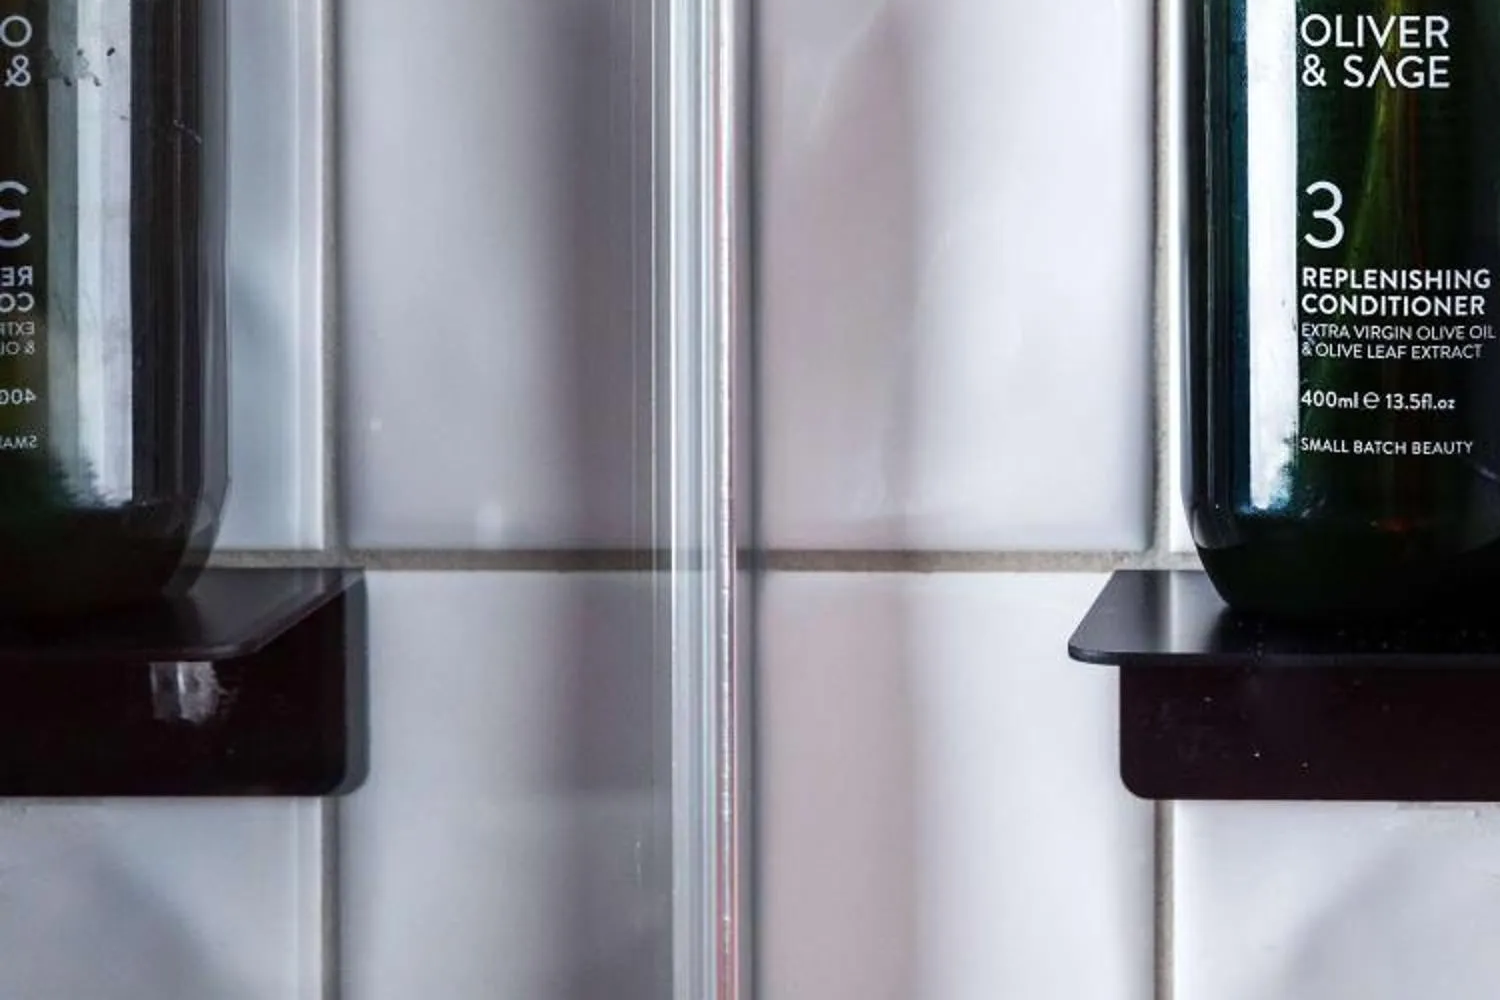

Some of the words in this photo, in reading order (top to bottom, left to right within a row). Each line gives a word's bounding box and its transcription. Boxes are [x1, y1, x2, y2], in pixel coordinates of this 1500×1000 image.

[1300, 13, 1450, 50] OLIVER
[1301, 53, 1328, 88] &
[1343, 54, 1450, 89] SAGE
[1304, 180, 1345, 250] 3
[1302, 268, 1491, 291] REPLENISHING
[1301, 293, 1485, 317] CONDITIONER
[1301, 324, 1350, 339] EXTRA
[1354, 325, 1412, 340] VIRGIN
[1416, 325, 1464, 340] OLIVE
[1469, 325, 1497, 340] OIL
[1301, 342, 1313, 357] &
[1315, 342, 1363, 359] OLIVE
[1367, 344, 1406, 360] LEAF
[1411, 344, 1482, 360] EXTRACT
[1301, 390, 1358, 410] 400ml
[1386, 392, 1455, 411] 13.5fl.oz
[1300, 438, 1349, 453] SMALL
[1354, 439, 1407, 454] BATCH
[1411, 440, 1473, 455] BEAUTY
